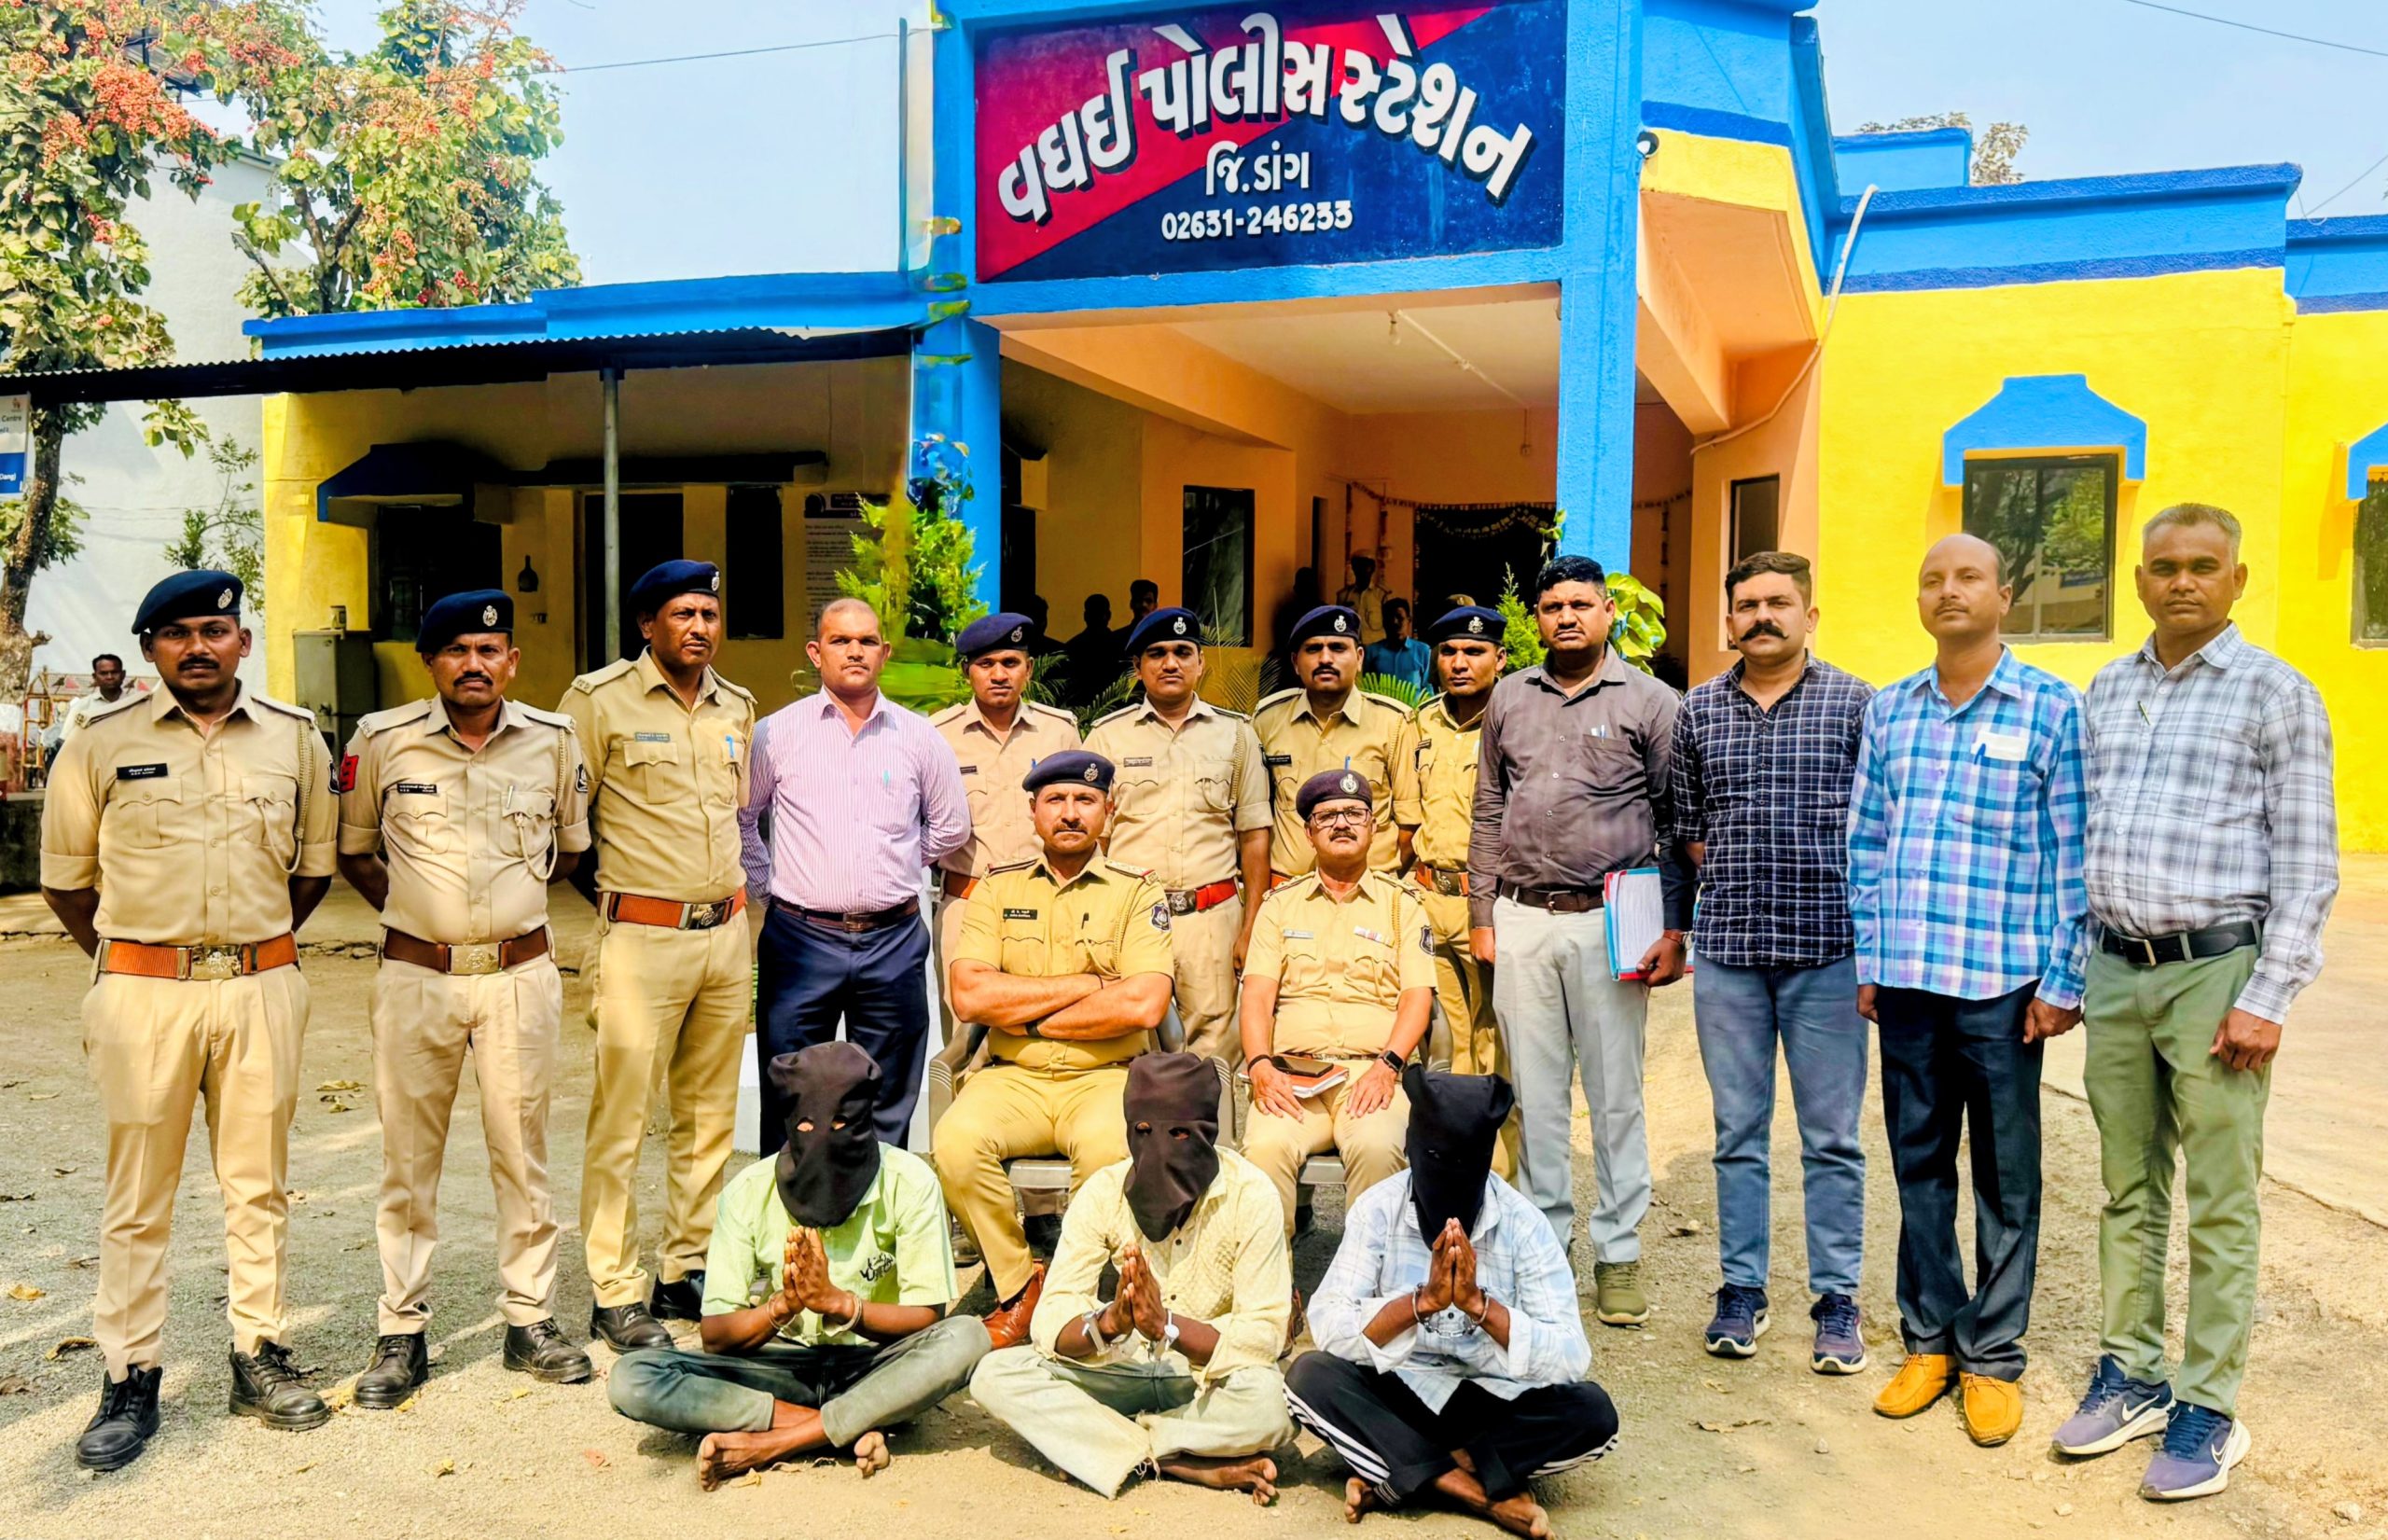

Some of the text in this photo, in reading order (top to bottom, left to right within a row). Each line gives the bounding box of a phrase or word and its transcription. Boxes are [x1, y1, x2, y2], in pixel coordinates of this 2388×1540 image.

[998, 12, 1534, 224] વઘઈ પોલીસ સ્ટેશન
[1161, 200, 1353, 240] 02631-246233
